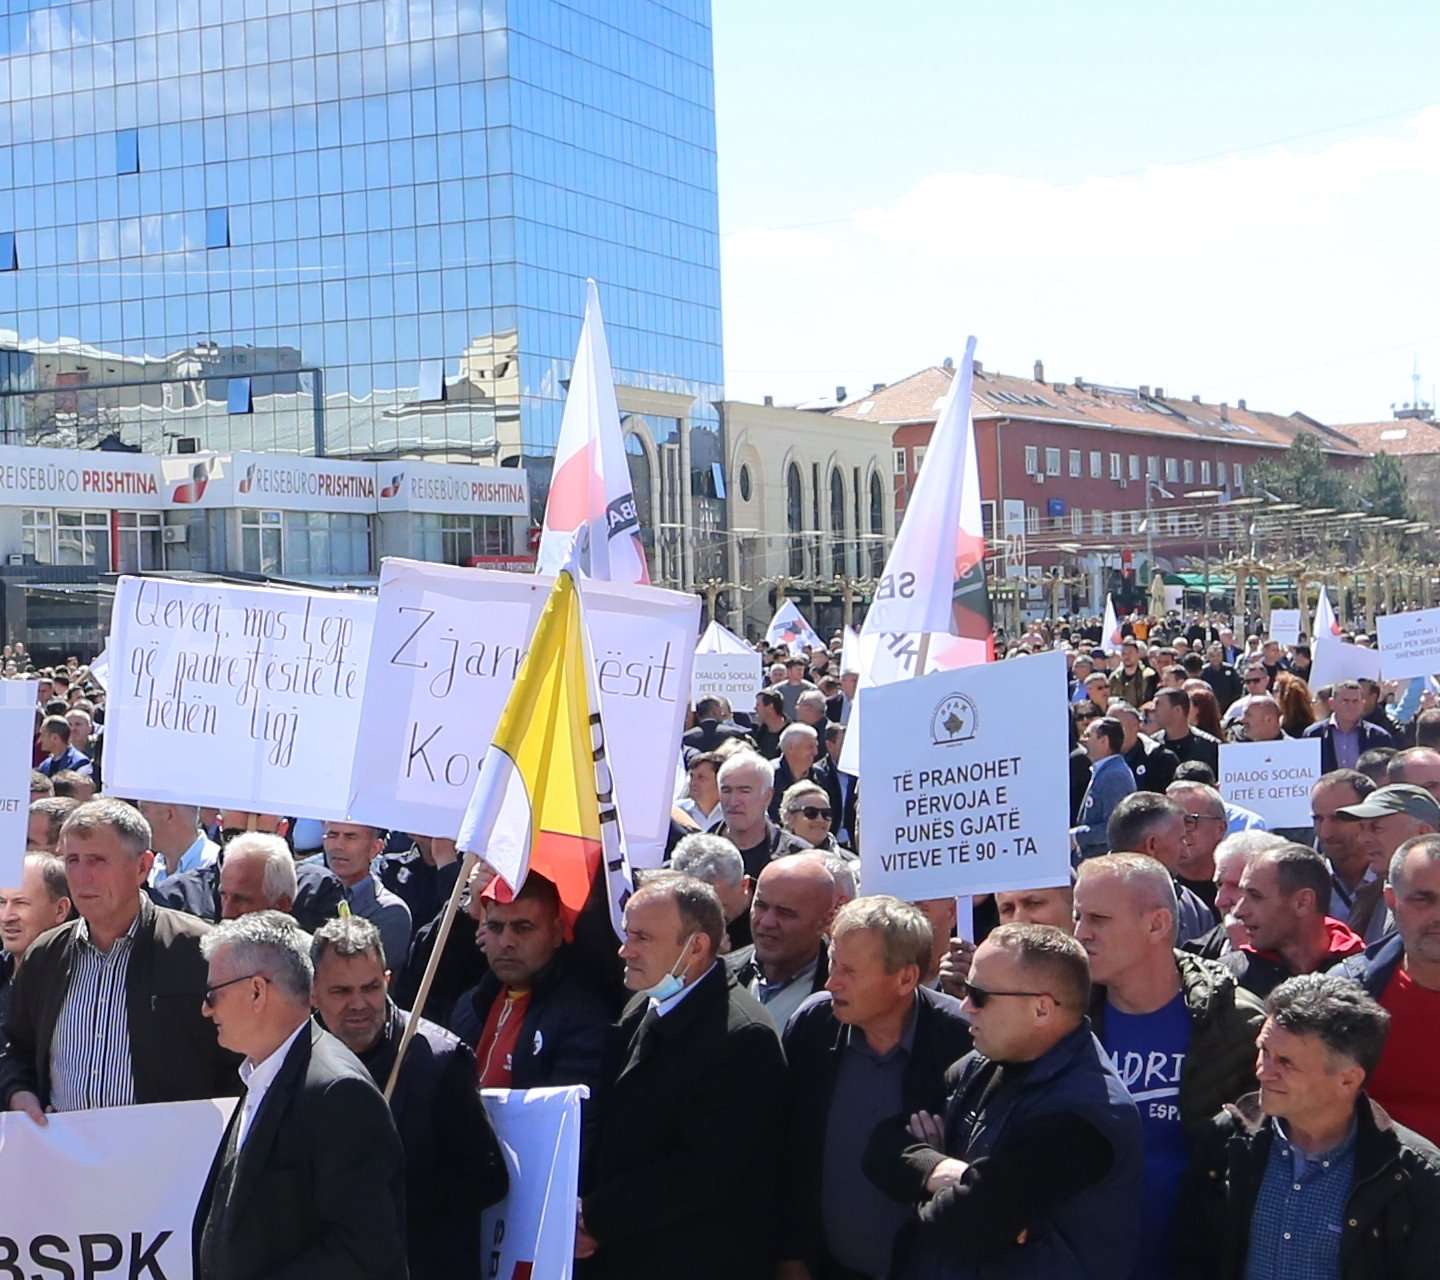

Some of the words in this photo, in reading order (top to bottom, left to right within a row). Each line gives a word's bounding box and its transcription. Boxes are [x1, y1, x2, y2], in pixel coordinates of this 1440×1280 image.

[82, 469, 158, 495] PRISHTINA
[256, 468, 318, 495] REISEBÜRO
[319, 473, 376, 499] PRISHTINA
[410, 476, 470, 502] REISEBÜRO
[471, 480, 525, 504] PRISHTINA
[243, 607, 287, 640] mos
[893, 770, 913, 793] TË
[919, 756, 1022, 789] PRANOHET
[1224, 769, 1269, 784] DIALOG
[1271, 767, 1315, 782] SOCIAL
[905, 790, 991, 817] PËRVOJA
[996, 786, 1008, 805] E
[1229, 787, 1255, 801] JETË
[1257, 788, 1265, 800] E
[1270, 784, 1309, 799] QETËSI
[895, 819, 954, 845] PUNËS
[960, 808, 1021, 836] GJATË
[881, 848, 942, 872] VITEVE
[948, 840, 970, 864] TË
[976, 841, 996, 861] 90
[1013, 836, 1038, 857] TA
